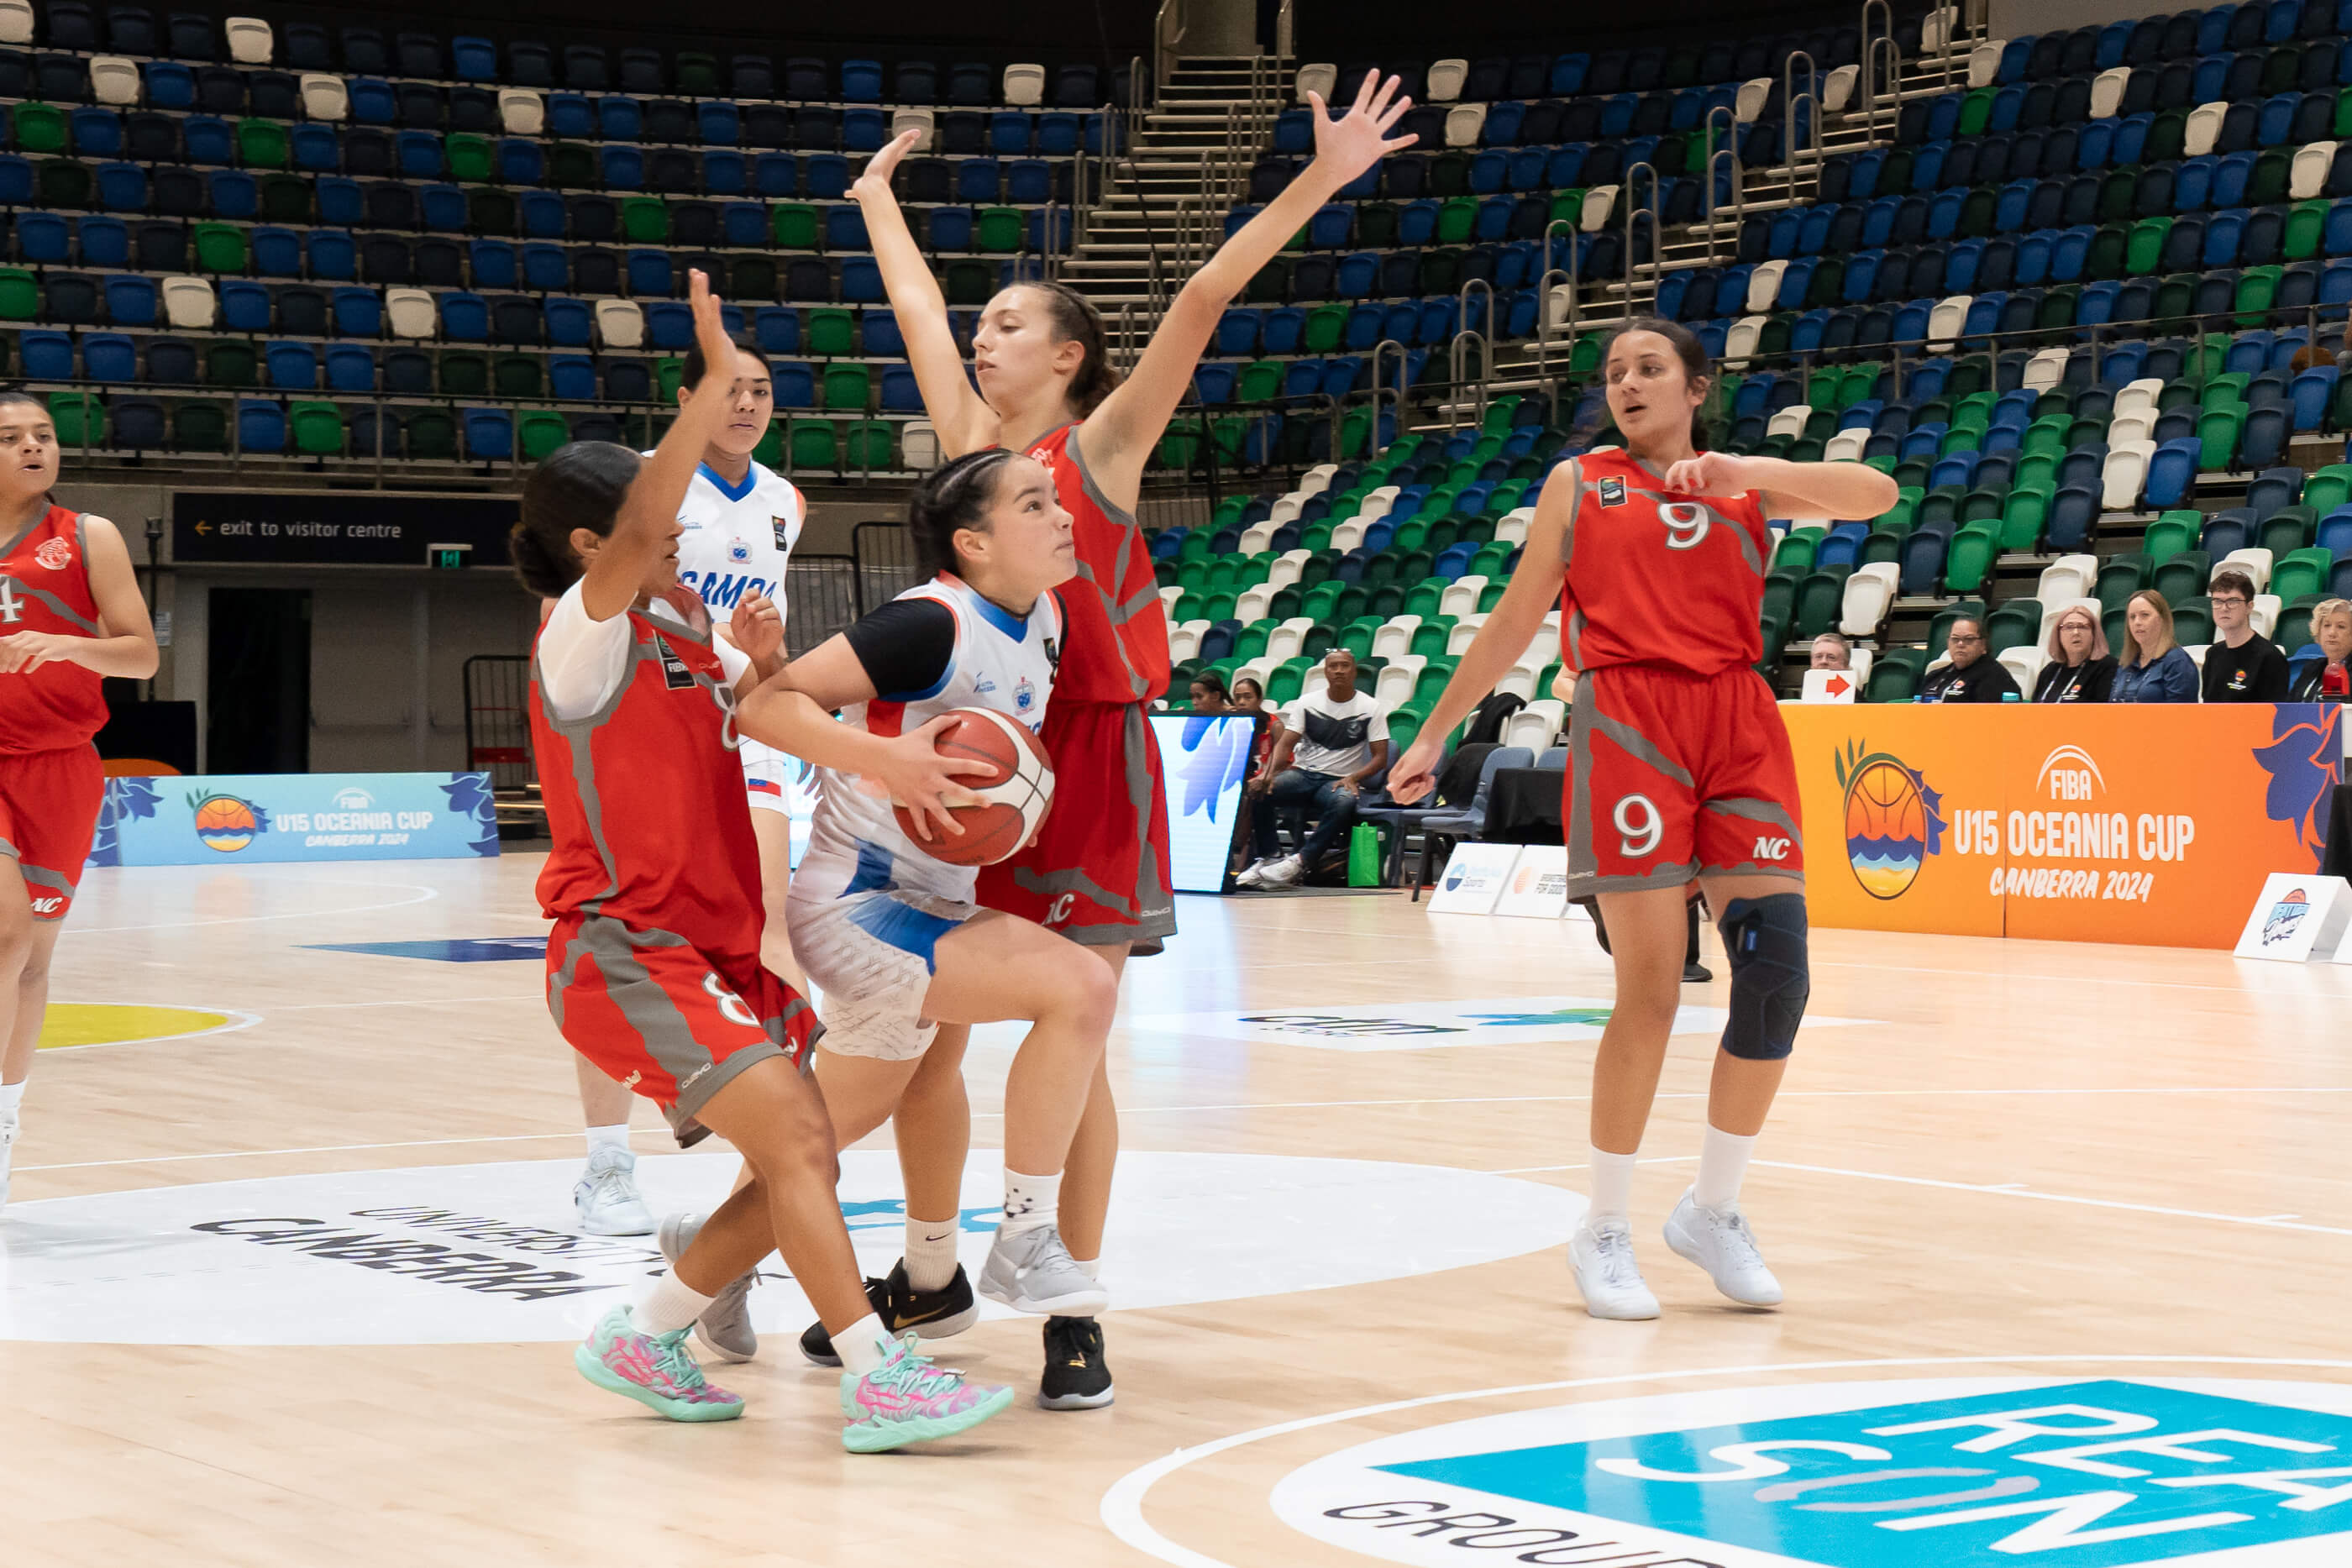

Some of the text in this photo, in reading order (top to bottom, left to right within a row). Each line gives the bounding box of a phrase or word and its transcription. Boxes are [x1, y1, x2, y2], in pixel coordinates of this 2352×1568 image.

[220, 520, 402, 538] exit to visitor centre
[1657, 502, 1710, 551] 9
[2050, 768, 2092, 800] FIBA
[276, 810, 433, 832] U15 OCEANIA CUP
[1612, 793, 1665, 858] 9
[1954, 809, 2196, 863] U15 OCEANIA CUP
[1752, 836, 1791, 861] NC
[1989, 867, 2155, 904] CANBERRA 2024
[30, 896, 64, 914] NC
[189, 1217, 629, 1302] CANBERRA
